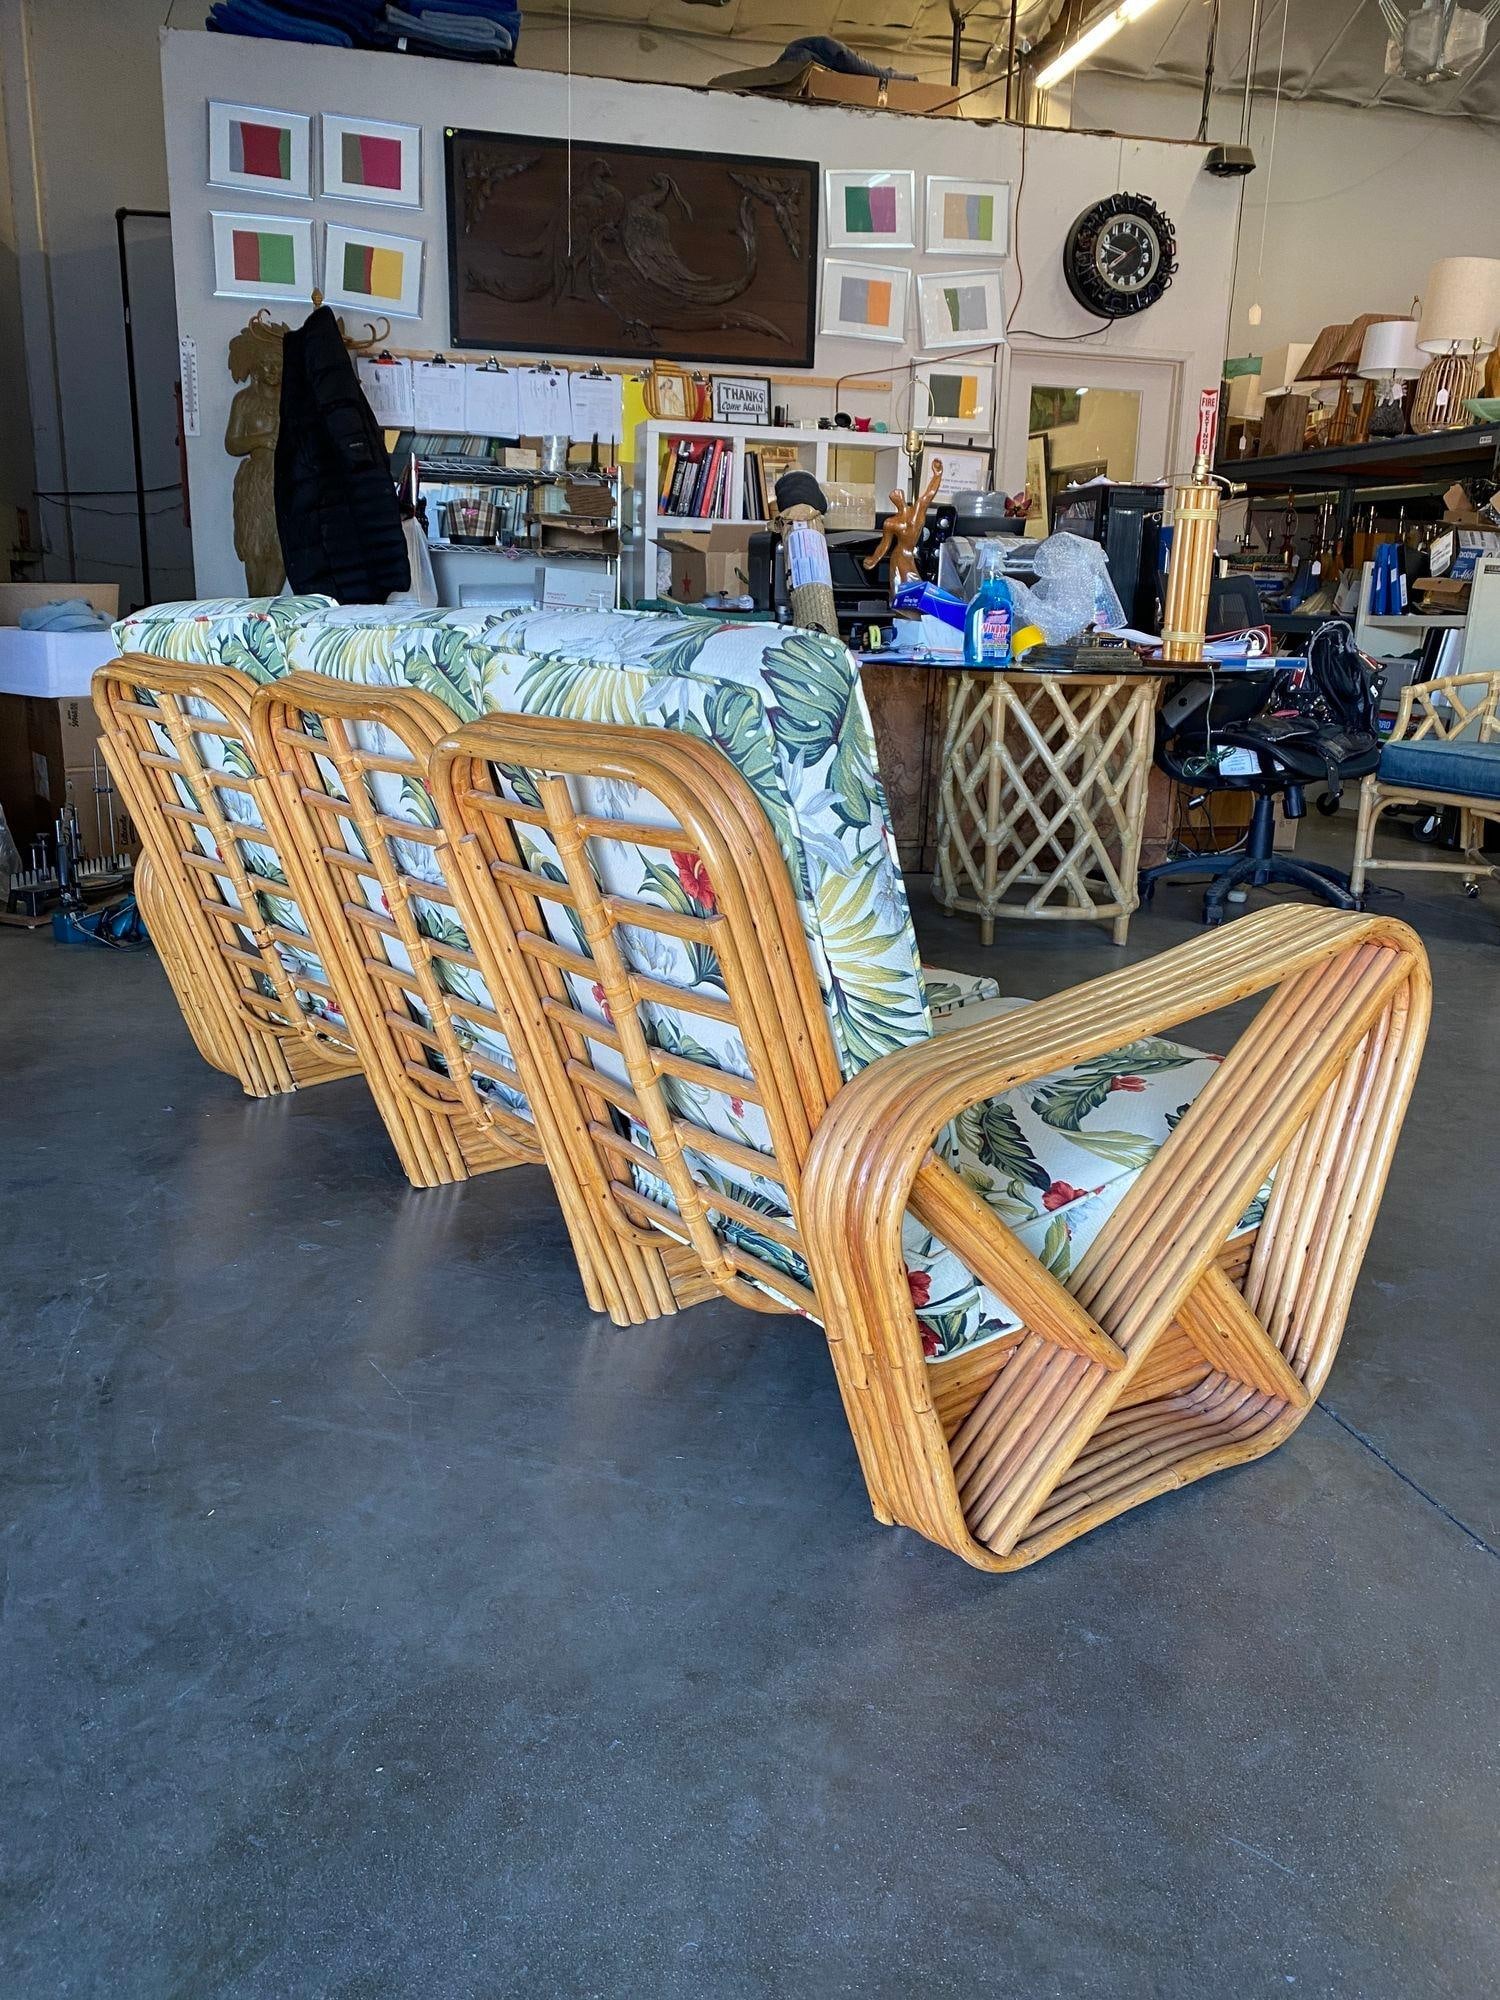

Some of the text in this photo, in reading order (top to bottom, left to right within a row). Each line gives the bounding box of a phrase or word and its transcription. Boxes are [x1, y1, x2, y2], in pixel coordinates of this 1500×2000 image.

[1122, 221, 1132, 233] 12
[1142, 238, 1149, 249] 2
[1142, 252, 1149, 263] 3
[722, 386, 764, 403] THANKS
[743, 402, 763, 412] AGAIN
[1201, 397, 1216, 408] FIRE
